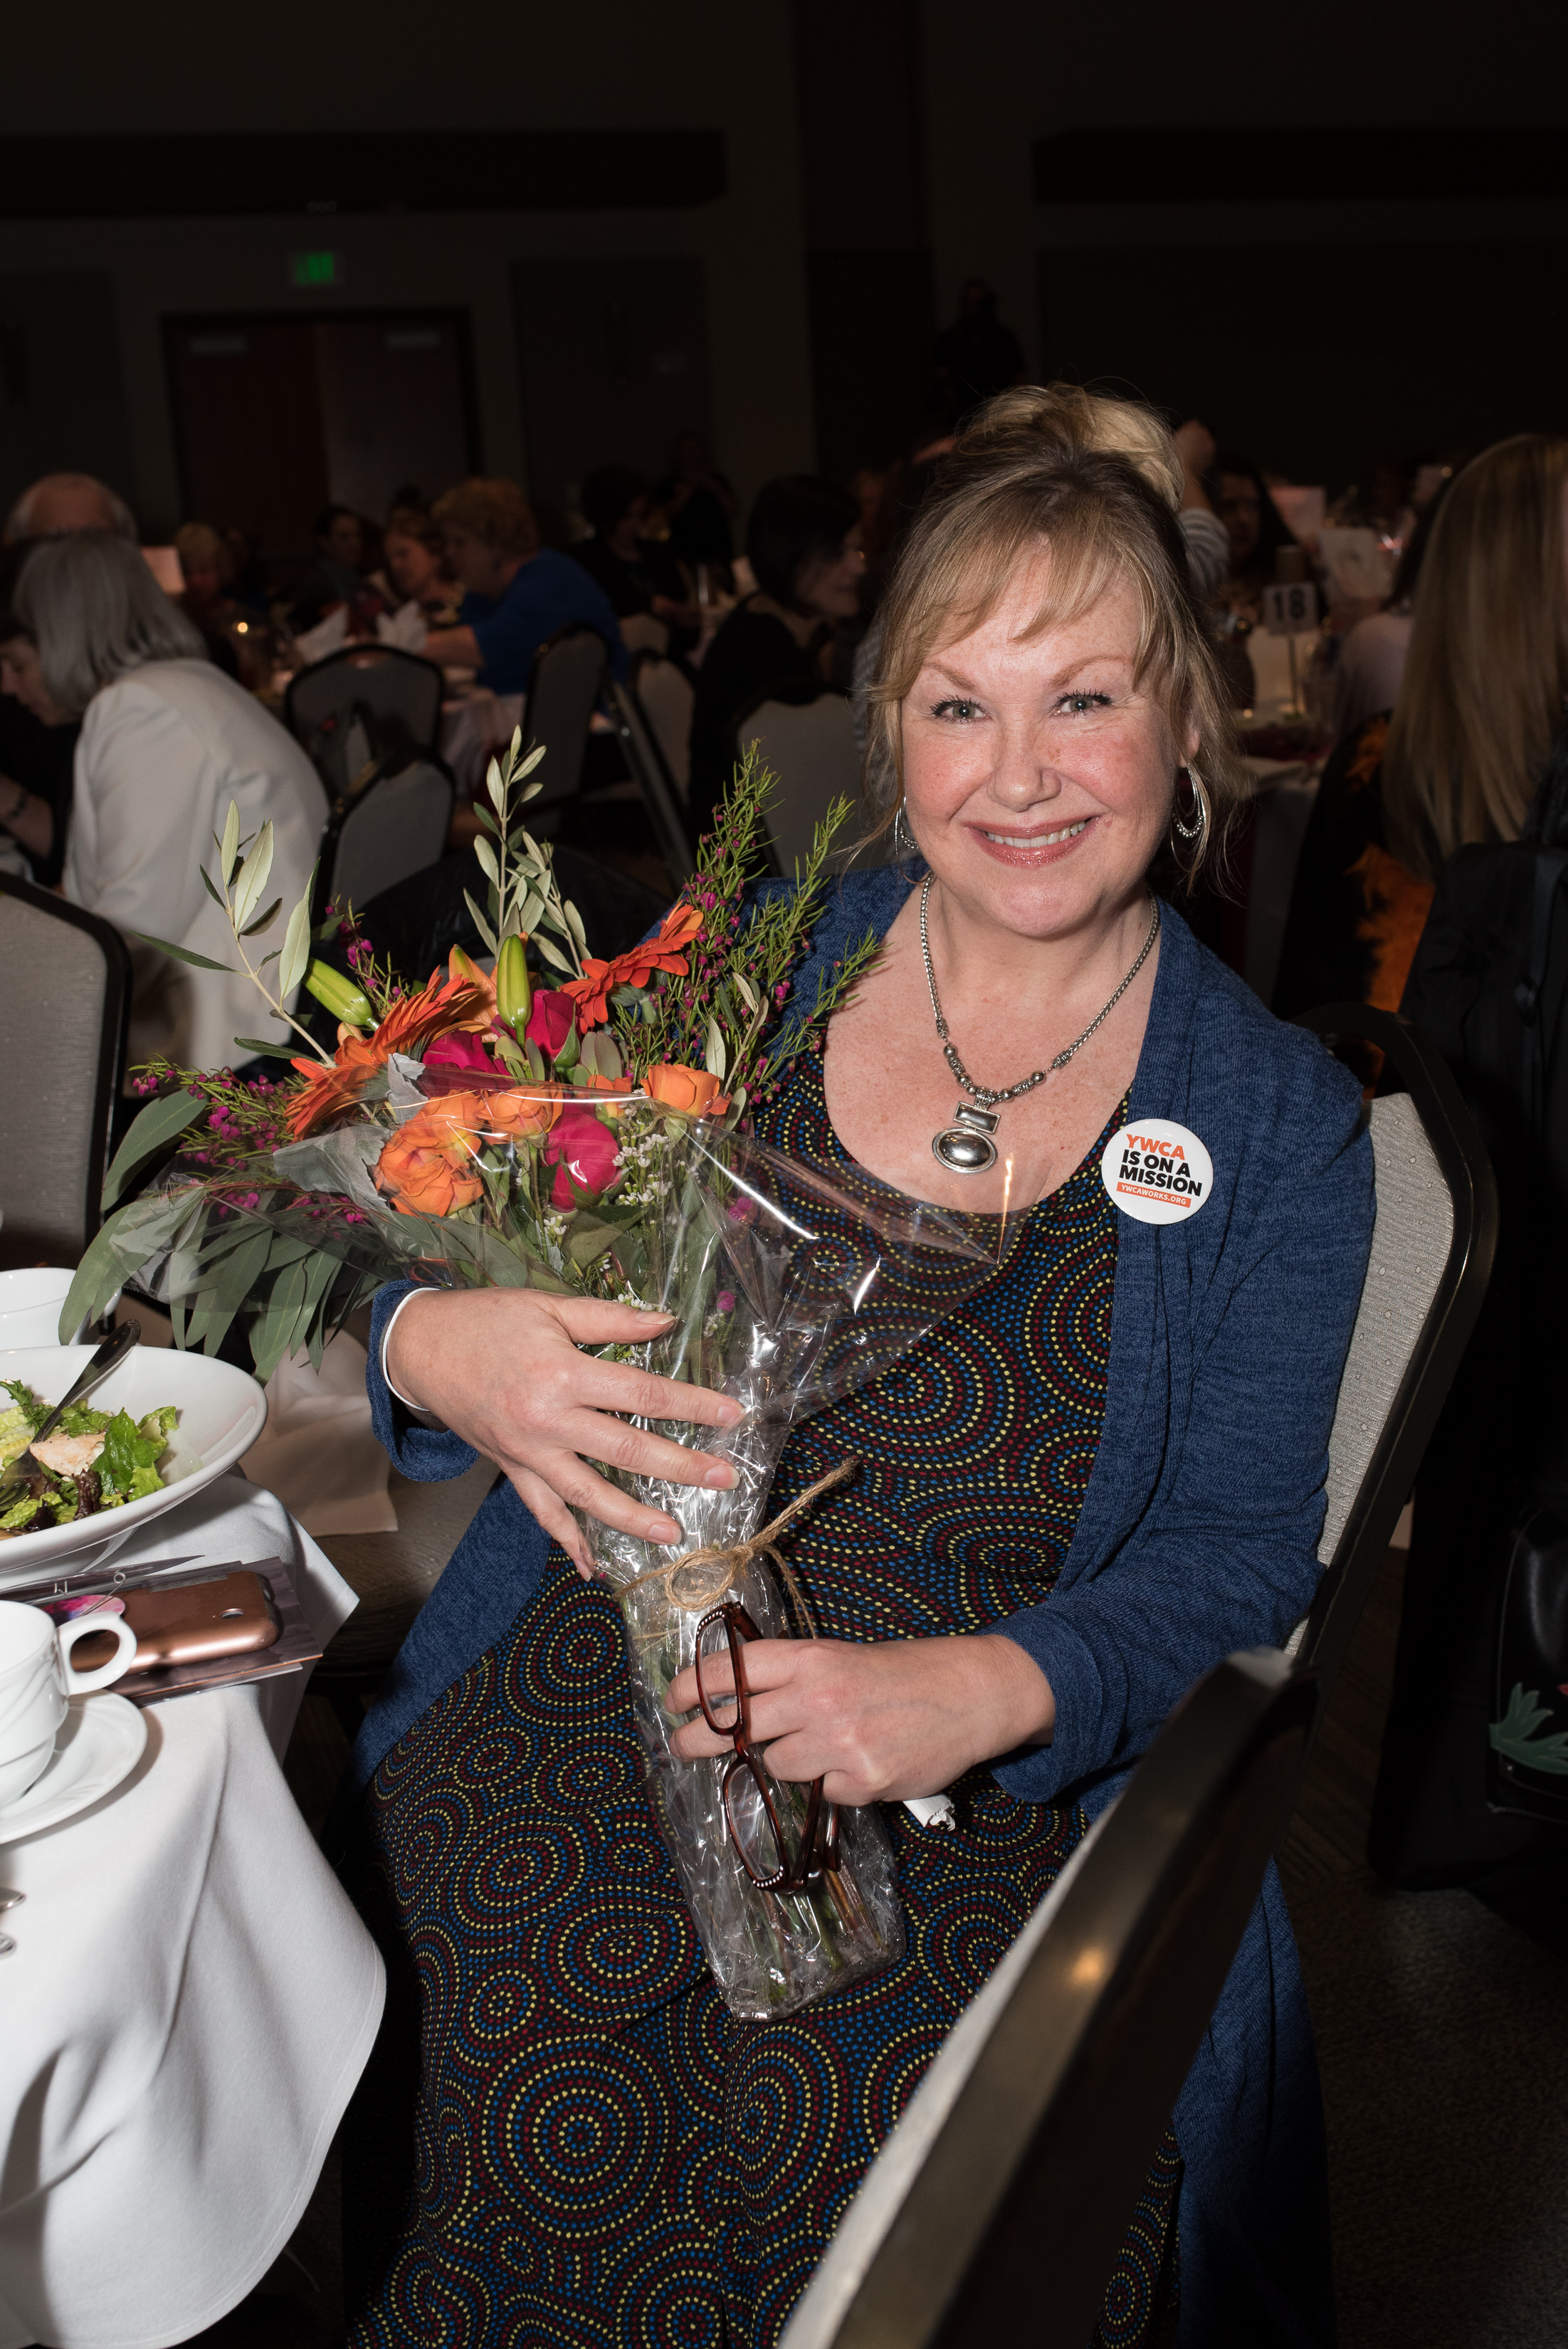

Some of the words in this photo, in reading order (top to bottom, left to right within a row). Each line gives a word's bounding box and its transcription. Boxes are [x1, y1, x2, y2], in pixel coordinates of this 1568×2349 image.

[1274, 589, 1305, 620] 18
[1126, 1134, 1185, 1160] YWCA
[1122, 1149, 1141, 1165] IS
[1144, 1155, 1174, 1173] ON
[1176, 1162, 1191, 1178] A
[1119, 1165, 1202, 1197] MISSION
[1121, 1184, 1186, 1205] YWCAWORKS.ORG
